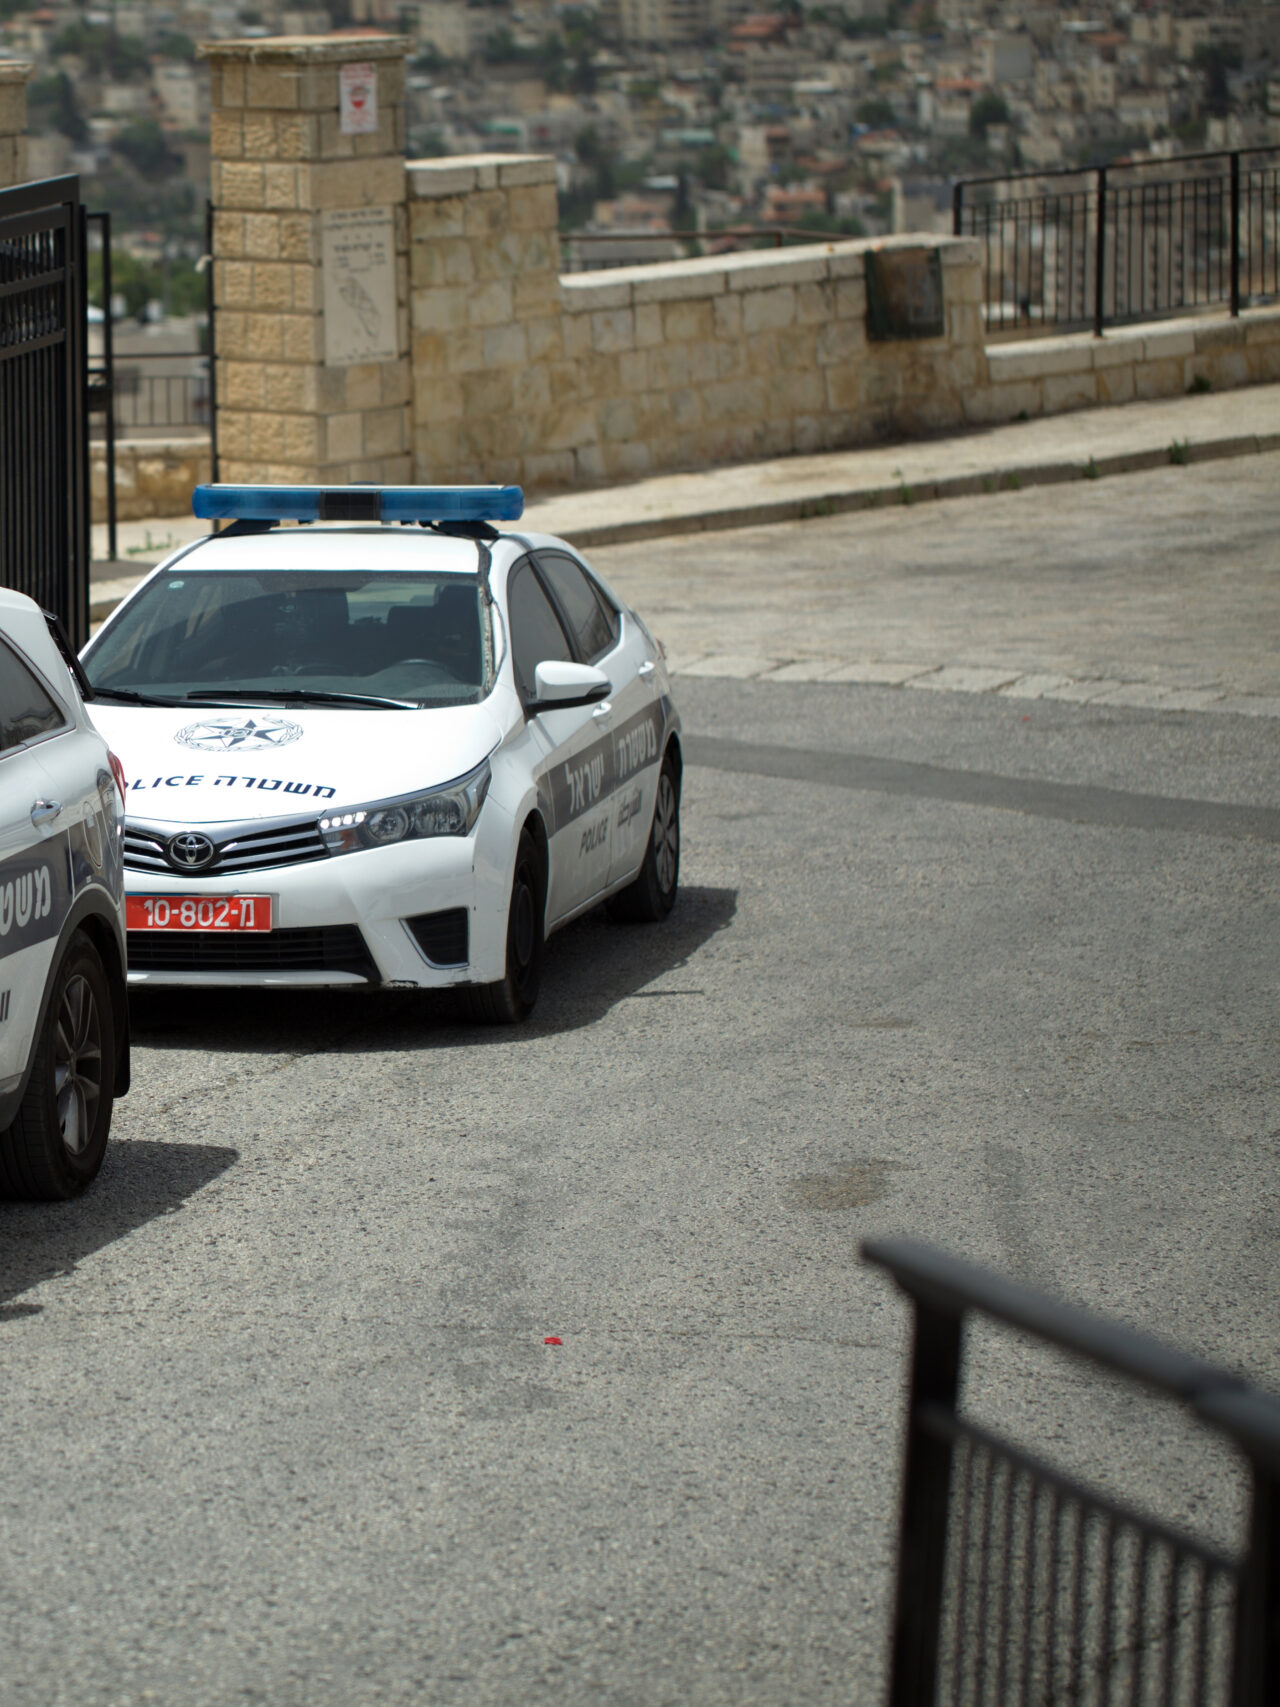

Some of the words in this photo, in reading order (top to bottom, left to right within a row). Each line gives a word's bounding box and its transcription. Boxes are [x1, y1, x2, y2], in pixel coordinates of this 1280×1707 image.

[618, 718, 657, 778] משטרת
[125, 775, 205, 791] LICE
[213, 775, 337, 799] משטרה
[564, 753, 605, 814] ישראל
[579, 816, 609, 858] POLICE
